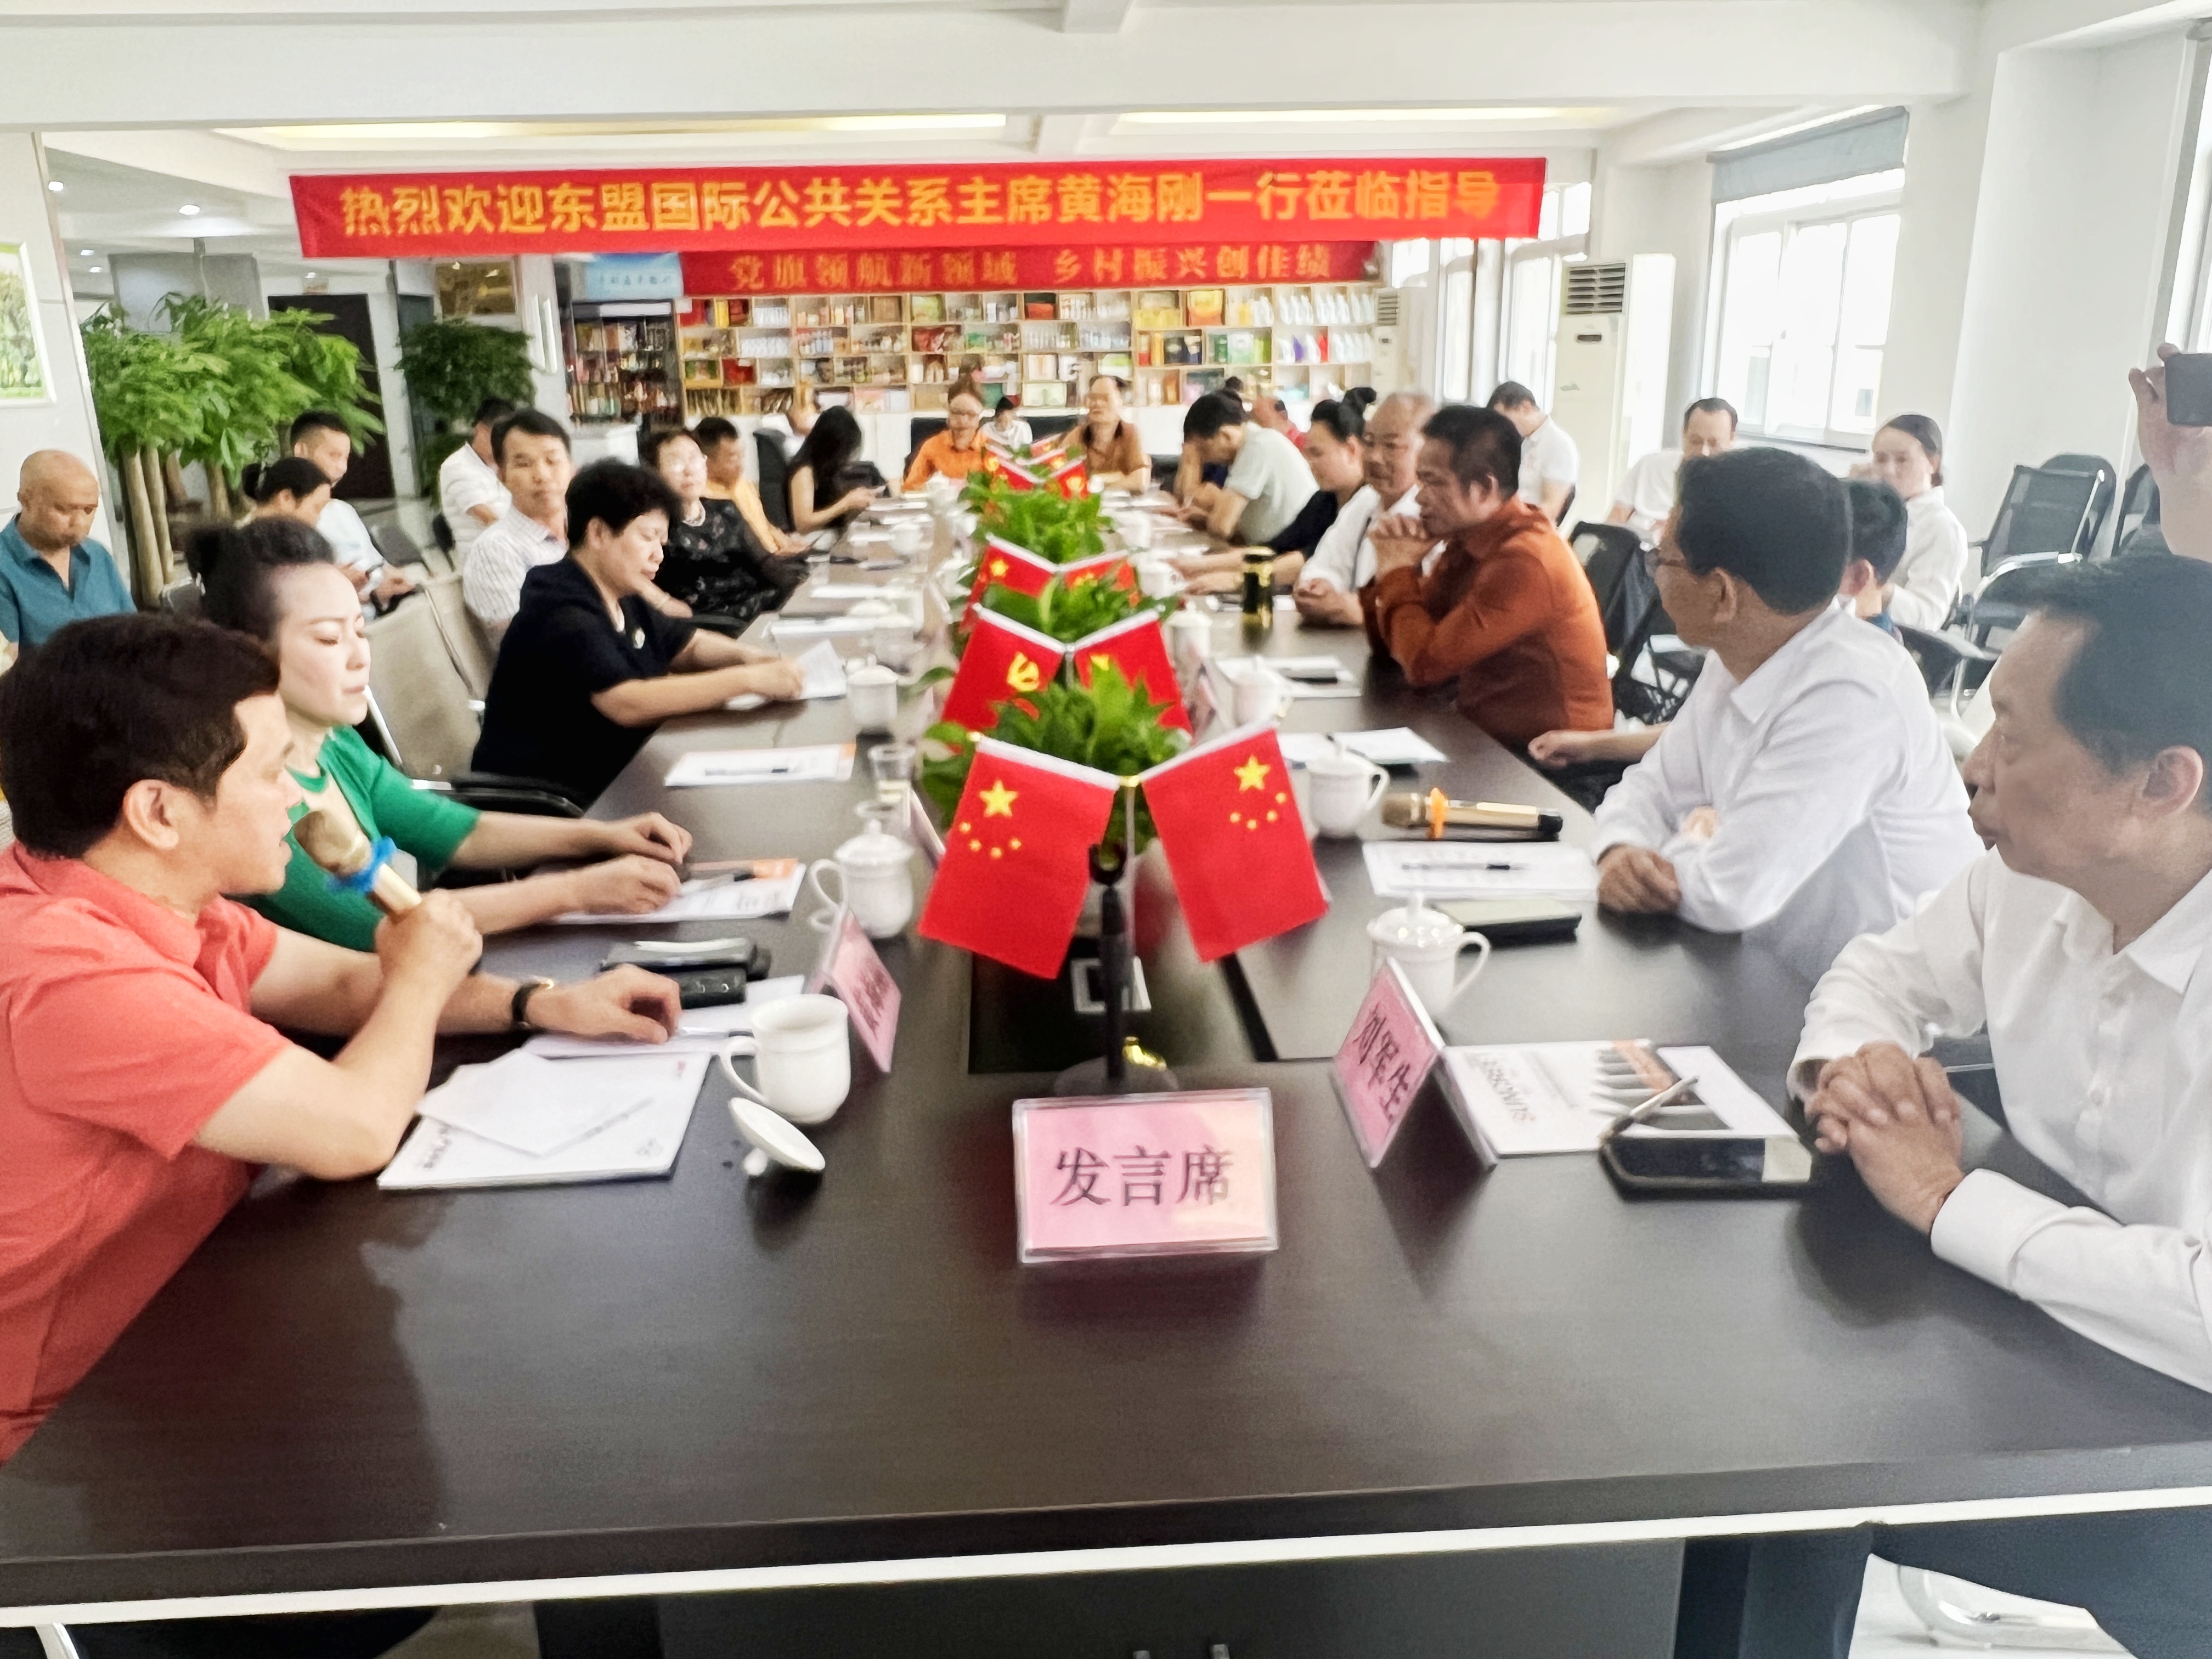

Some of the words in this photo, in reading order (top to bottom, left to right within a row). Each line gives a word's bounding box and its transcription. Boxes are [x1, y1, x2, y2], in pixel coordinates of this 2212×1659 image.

[339, 170, 1500, 237] 热烈欢迎东盟国际公共关系主席黄海刚一行莅临指导
[1049, 1144, 1235, 1207] 发言席
